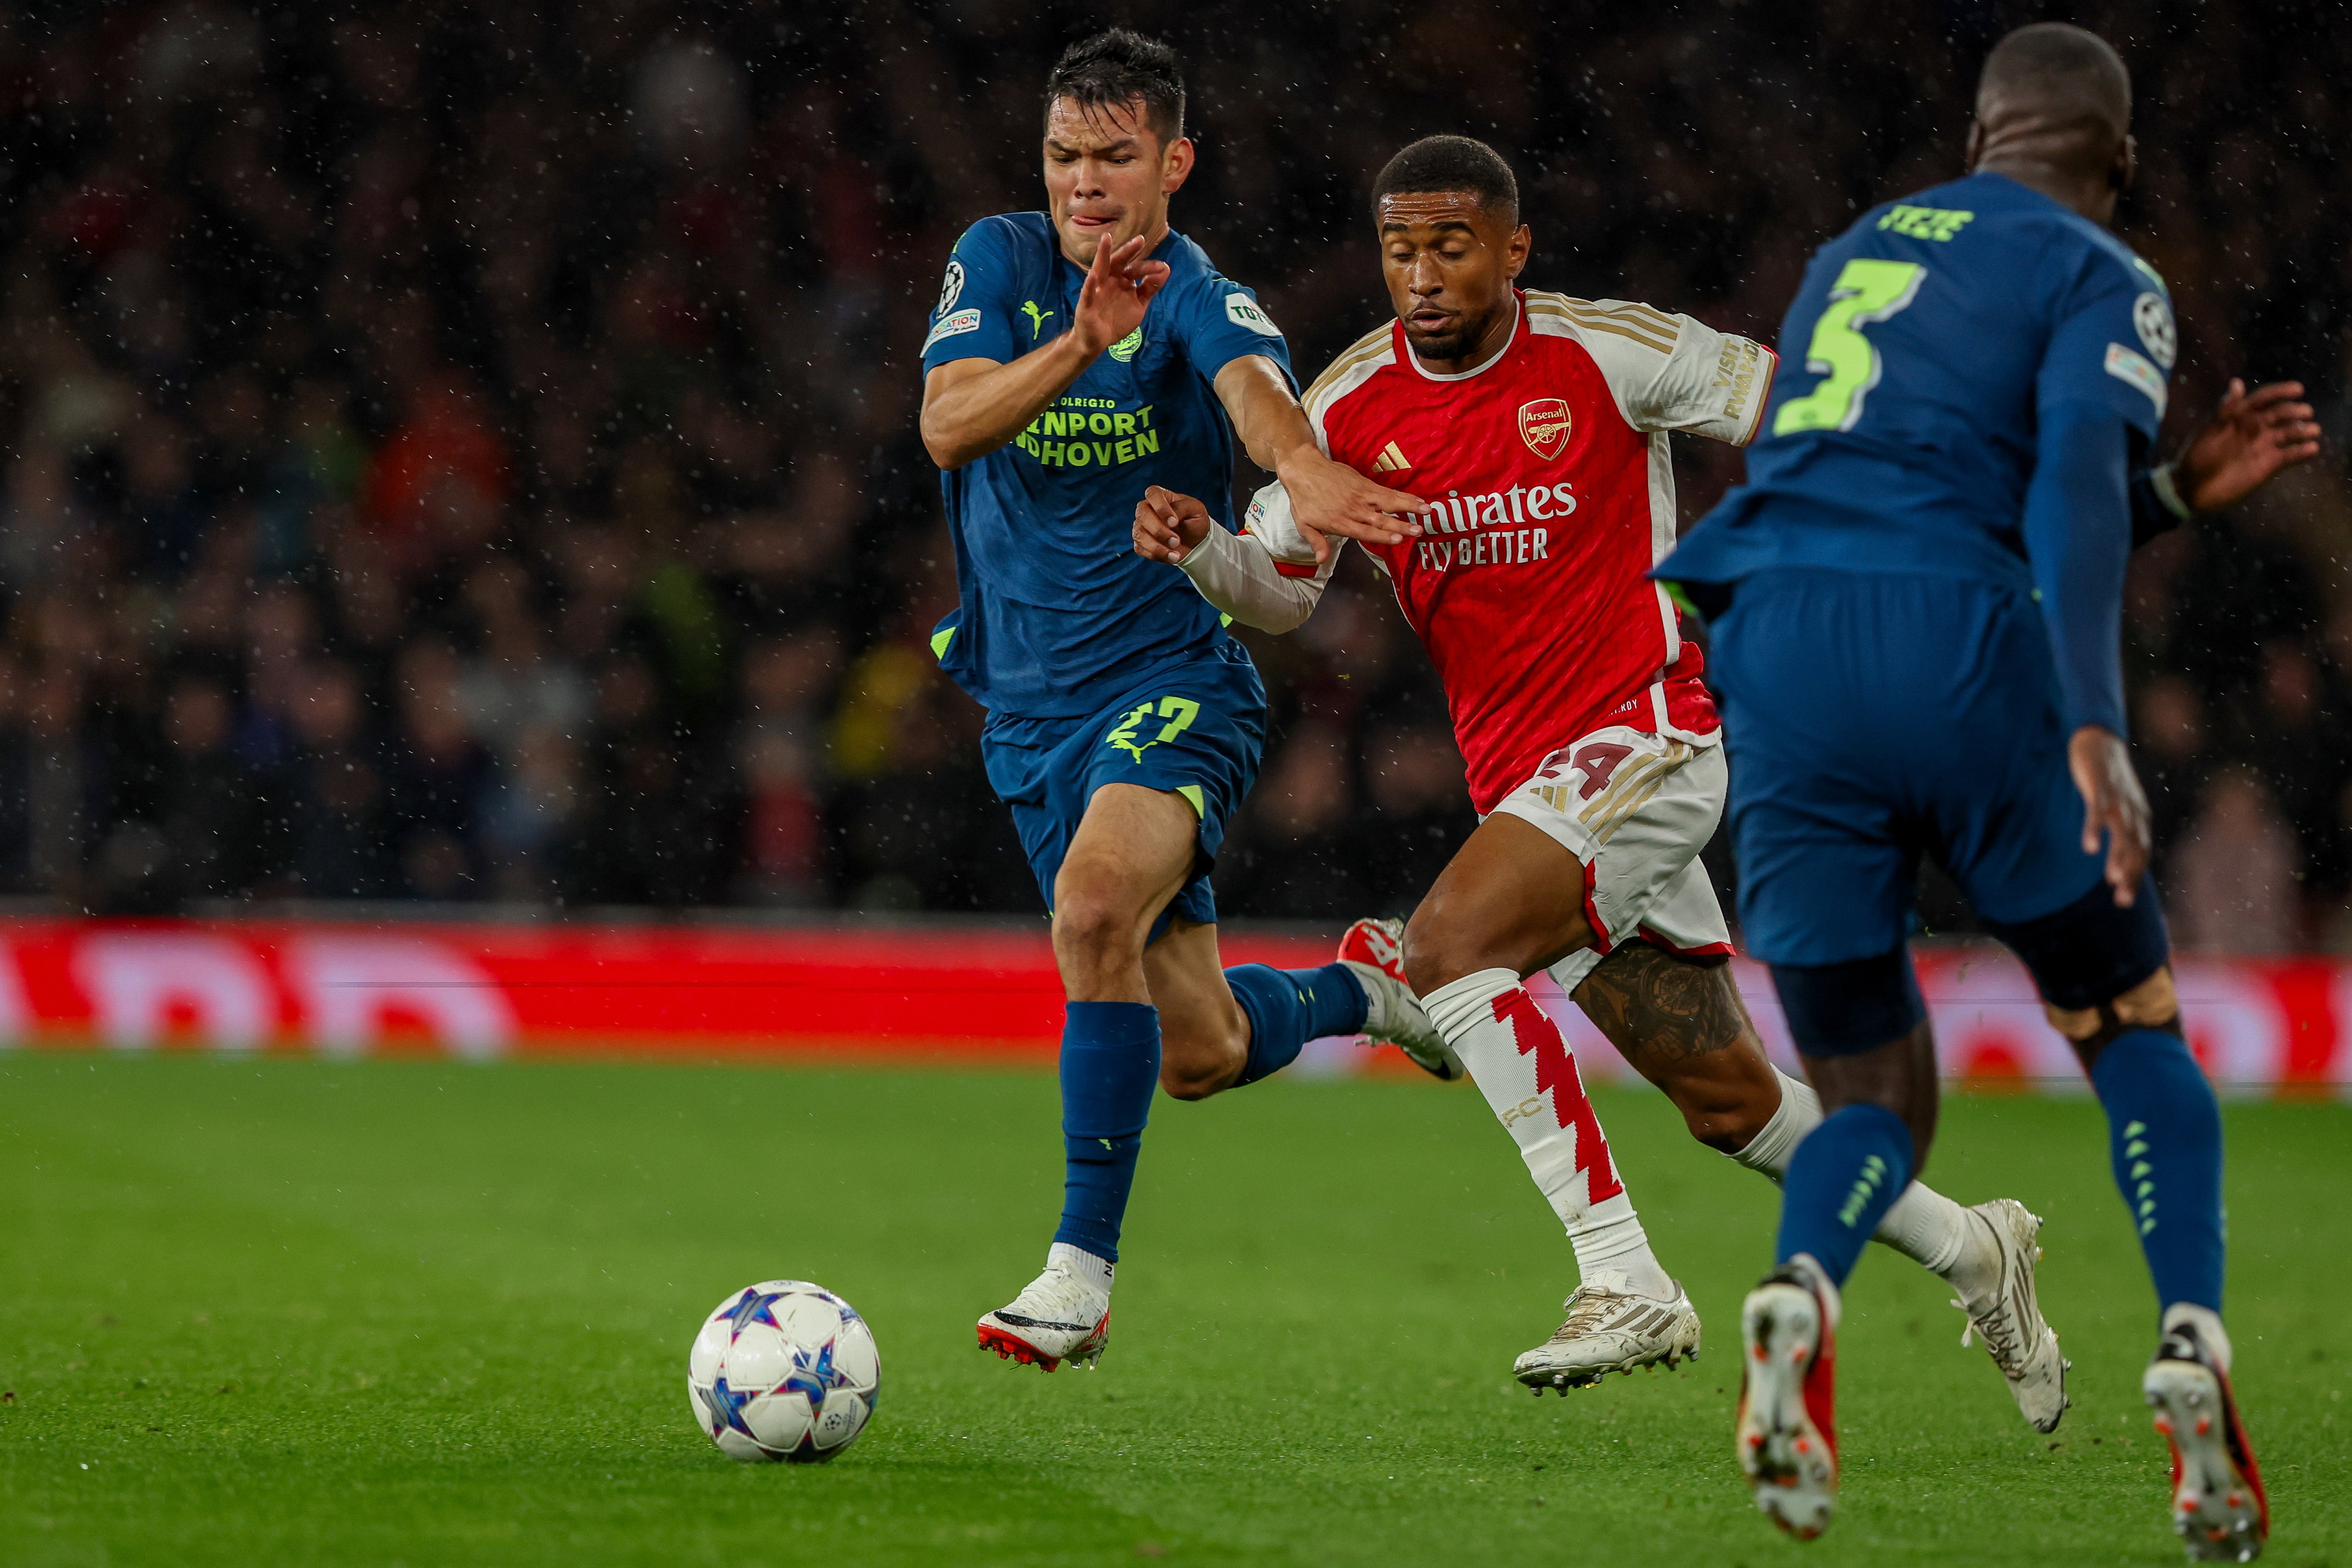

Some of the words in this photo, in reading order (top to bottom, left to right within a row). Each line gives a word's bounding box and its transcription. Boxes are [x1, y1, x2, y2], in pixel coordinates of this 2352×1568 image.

[1712, 339, 1741, 387] VISIT
[1772, 258, 1926, 438] 3
[1526, 408, 1563, 422] Arsenal
[1382, 482, 1577, 535] mirates
[1418, 541, 1451, 572] FLY
[1458, 527, 1548, 565] BETTER
[1105, 695, 1201, 743] 27
